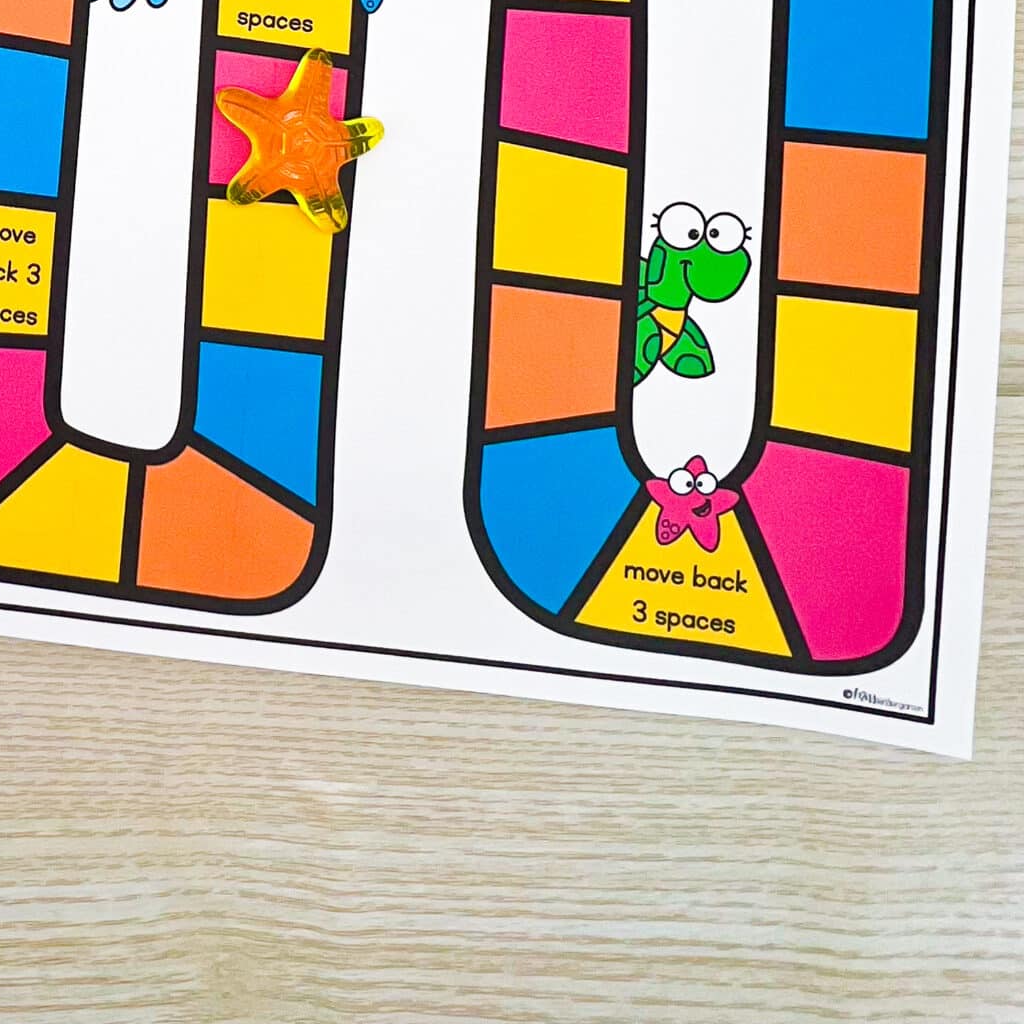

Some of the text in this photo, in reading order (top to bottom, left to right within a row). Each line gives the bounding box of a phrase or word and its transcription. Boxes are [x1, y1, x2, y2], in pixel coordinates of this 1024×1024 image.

[237, 11, 313, 32] spaces
[26, 263, 41, 285] 3
[624, 564, 748, 593] move back
[632, 599, 736, 634] 3 spaces
